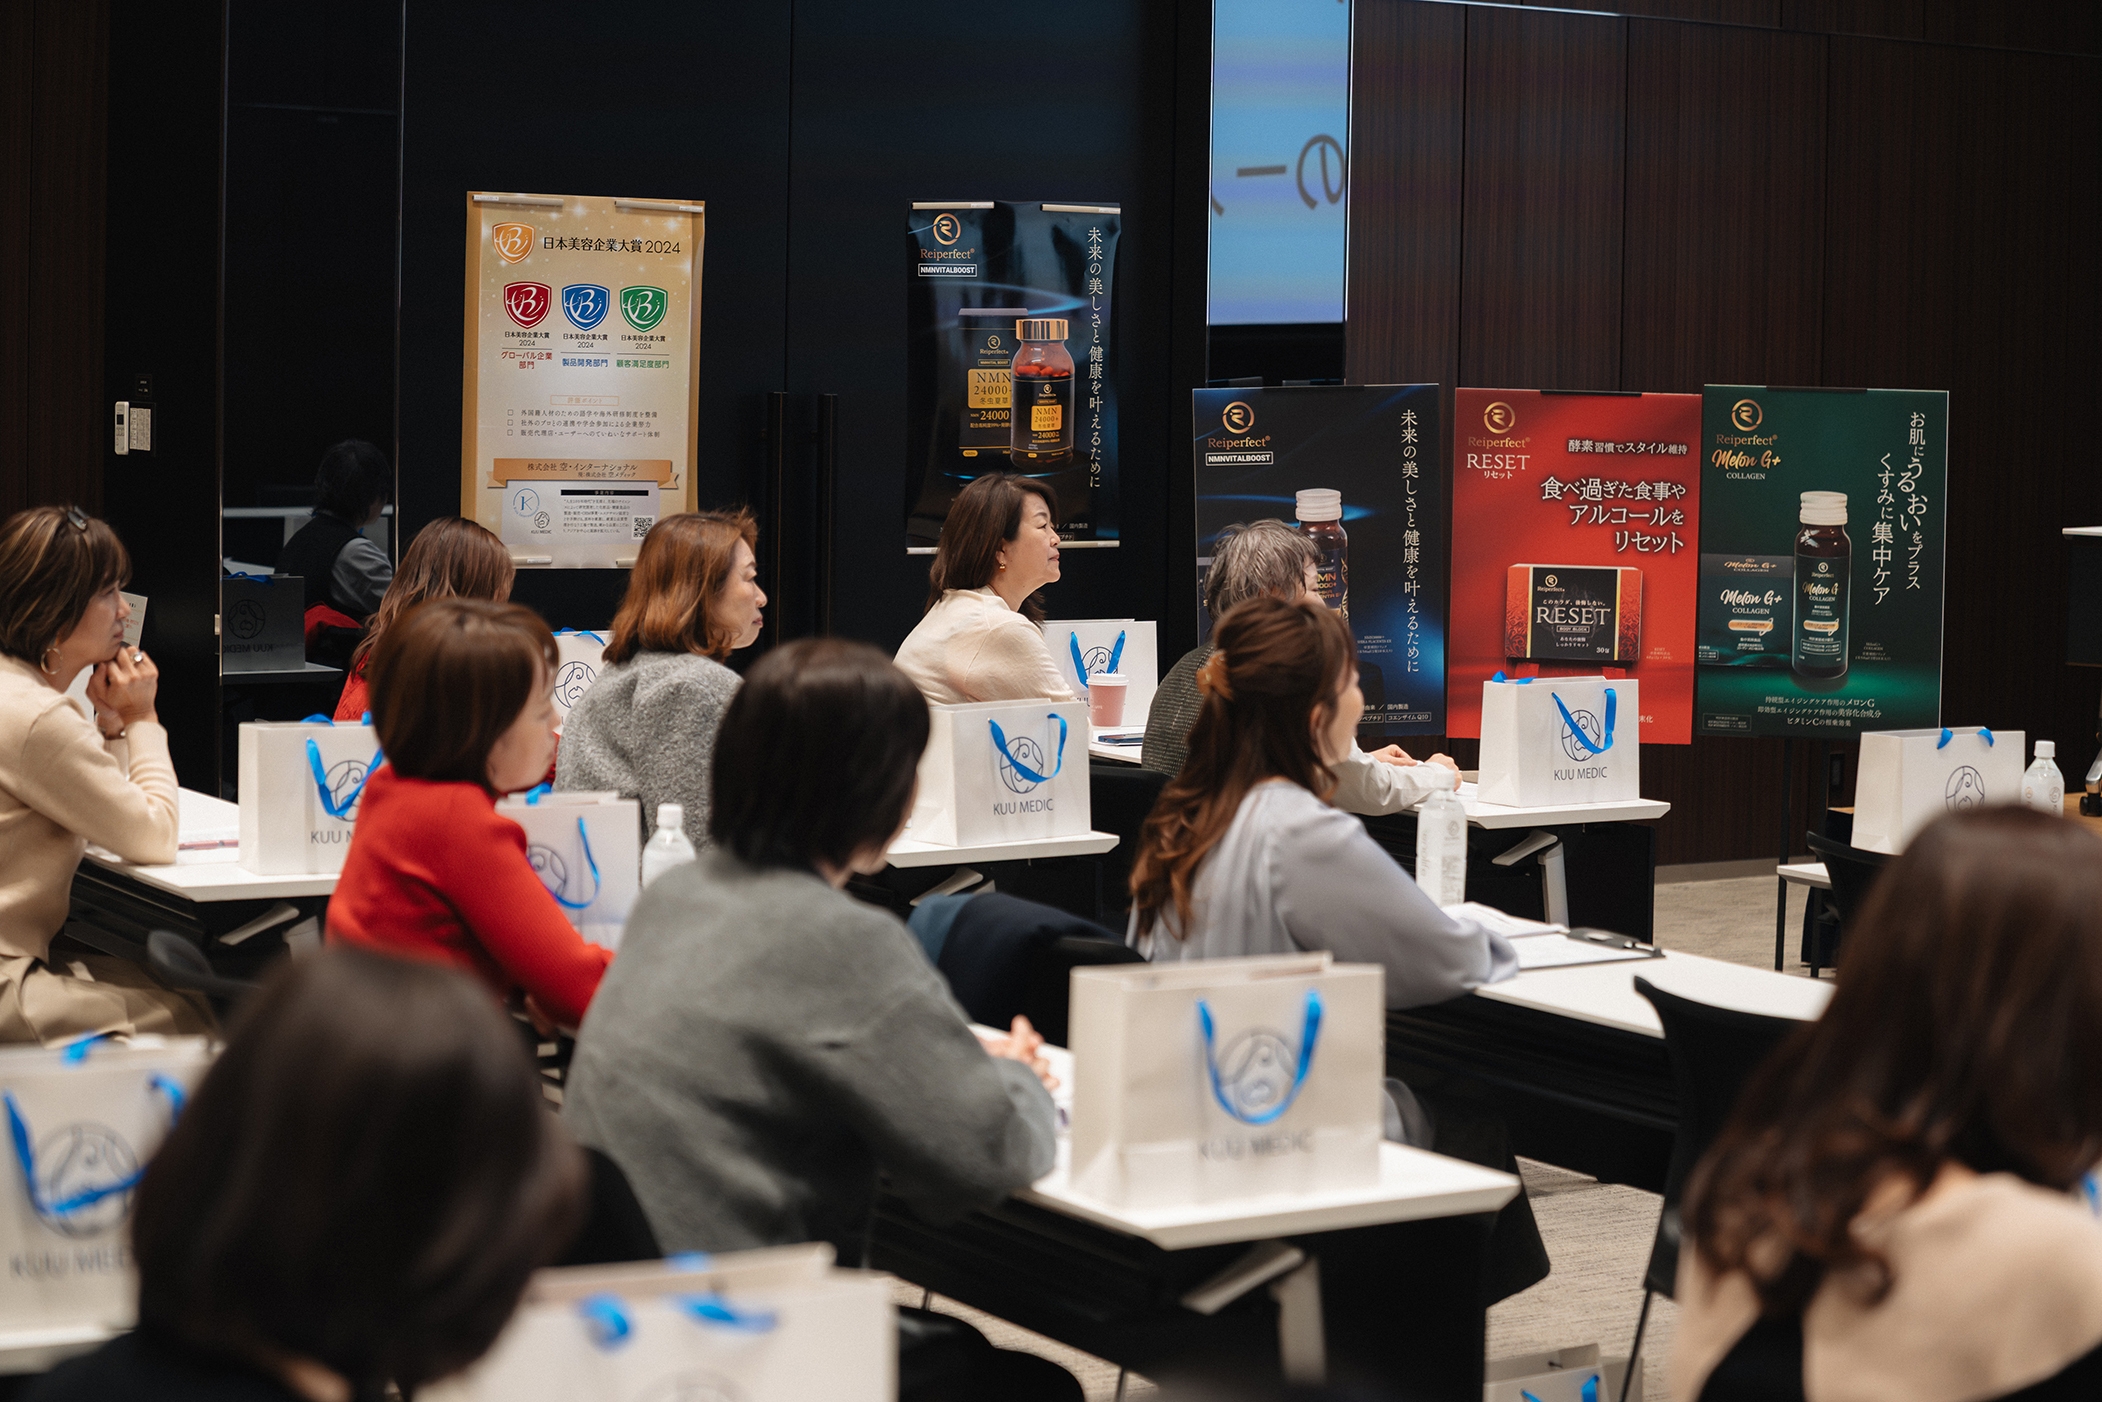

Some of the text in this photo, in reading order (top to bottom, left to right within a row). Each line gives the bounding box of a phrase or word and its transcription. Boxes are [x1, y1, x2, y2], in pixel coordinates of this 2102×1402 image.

[543, 236, 681, 254] 日本美容企業大賞 2024
[920, 266, 975, 275] NMNVITALBOOST
[505, 331, 550, 339] 日本美容企業大賞
[563, 333, 608, 341] 日本美容企業大賞
[621, 335, 666, 343] 日本美容企業大賞
[577, 341, 594, 349] 2024
[501, 351, 553, 361] グローバル企業
[1087, 227, 1104, 488] 未来の美しさと健康を叶えるために
[519, 361, 535, 370] 部門
[562, 358, 609, 368] 製品開発部門
[616, 359, 670, 369] 顧客満足度部門
[976, 372, 1011, 383] NMN
[980, 410, 1010, 421] 24000
[1568, 439, 1688, 455] 酵素習慣でスタイル維持
[1208, 454, 1271, 463] NMNVITALBOOST
[1466, 453, 1530, 470] RESET
[1711, 449, 1782, 470] Melon G+
[1484, 471, 1513, 479] リセット
[1726, 472, 1766, 480] COLLAGEN
[1540, 476, 1686, 501] 食べ過ぎた食事や
[1897, 412, 1928, 590] お肌にうるおいをプラス
[1568, 504, 1684, 526] アルコールを
[1871, 453, 1895, 605] くすみに集中ケア
[1401, 409, 1421, 673] 未来の美しさと健康を叶えるために
[1615, 531, 1684, 553] リセット
[1724, 561, 1759, 569] Melon
[1802, 581, 1830, 596] Melon
[1720, 589, 1782, 606] Melon G+
[1536, 607, 1611, 625] RESET
[1732, 607, 1770, 615] COLLAGEN
[1387, 703, 1409, 711] 国内製造
[1554, 766, 1608, 781] KUU MEDIC
[993, 798, 1054, 816] KUU MEDIC
[310, 830, 341, 844] KUU
